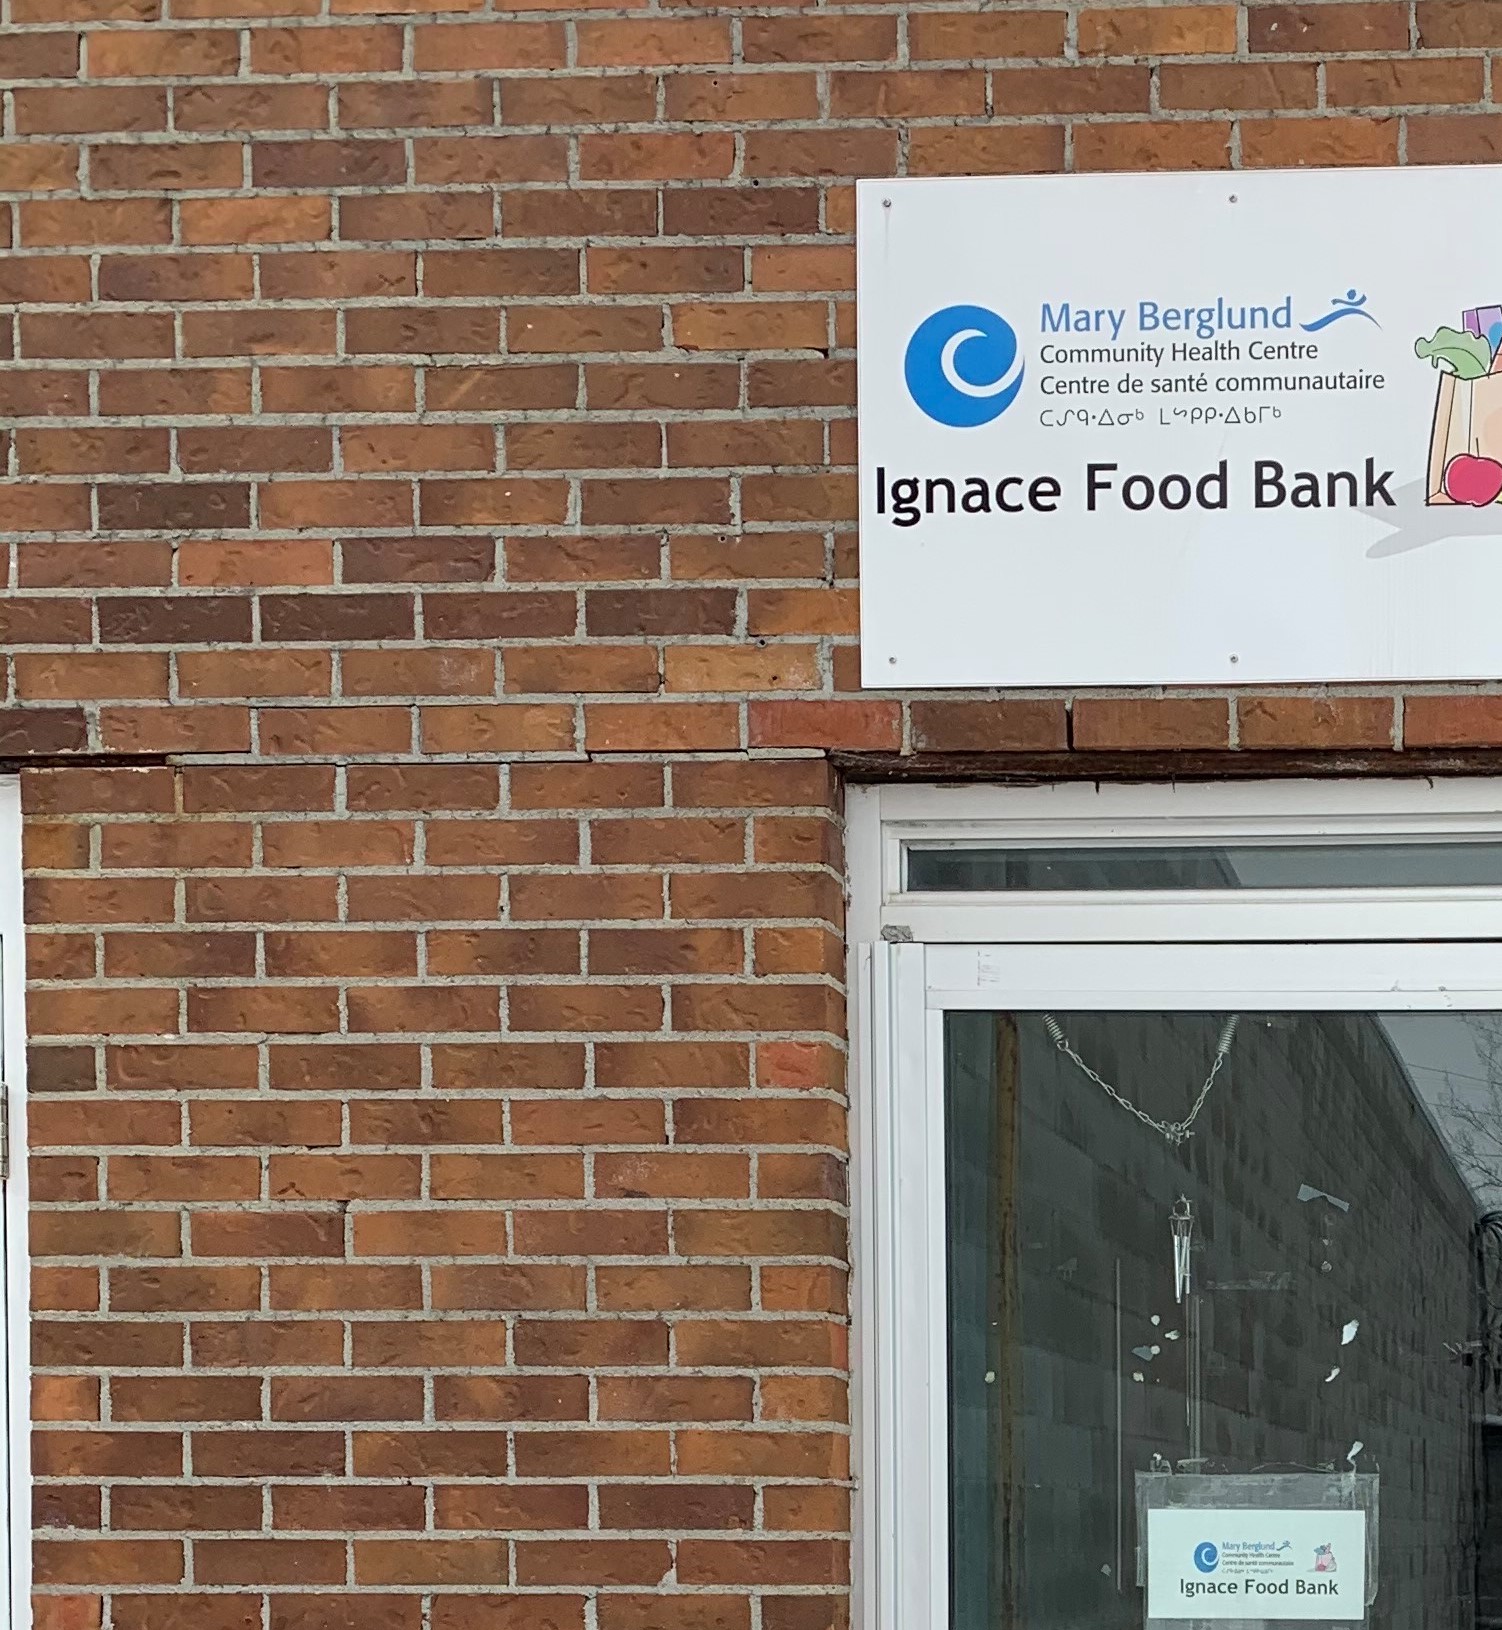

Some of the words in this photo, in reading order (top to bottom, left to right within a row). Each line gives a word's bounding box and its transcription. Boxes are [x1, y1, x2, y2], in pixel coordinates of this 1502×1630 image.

[1041, 302, 1126, 341] Mary
[1139, 296, 1292, 338] Berglund
[1040, 341, 1165, 367] Community
[1172, 337, 1240, 361] Health
[1248, 340, 1319, 361] Centre
[1040, 374, 1110, 395] Centre
[1117, 370, 1145, 393] de
[1150, 370, 1208, 393] santé
[1215, 367, 1385, 392] communautaire
[876, 466, 1062, 528] Ignace
[1086, 459, 1229, 511] Food
[1254, 456, 1397, 508] Bank
[1222, 1541, 1241, 1552] Mary
[1242, 1541, 1275, 1552] Berglund
[1180, 1578, 1238, 1597] Ignace
[1245, 1578, 1289, 1595] Food
[1295, 1578, 1339, 1595] Bank
